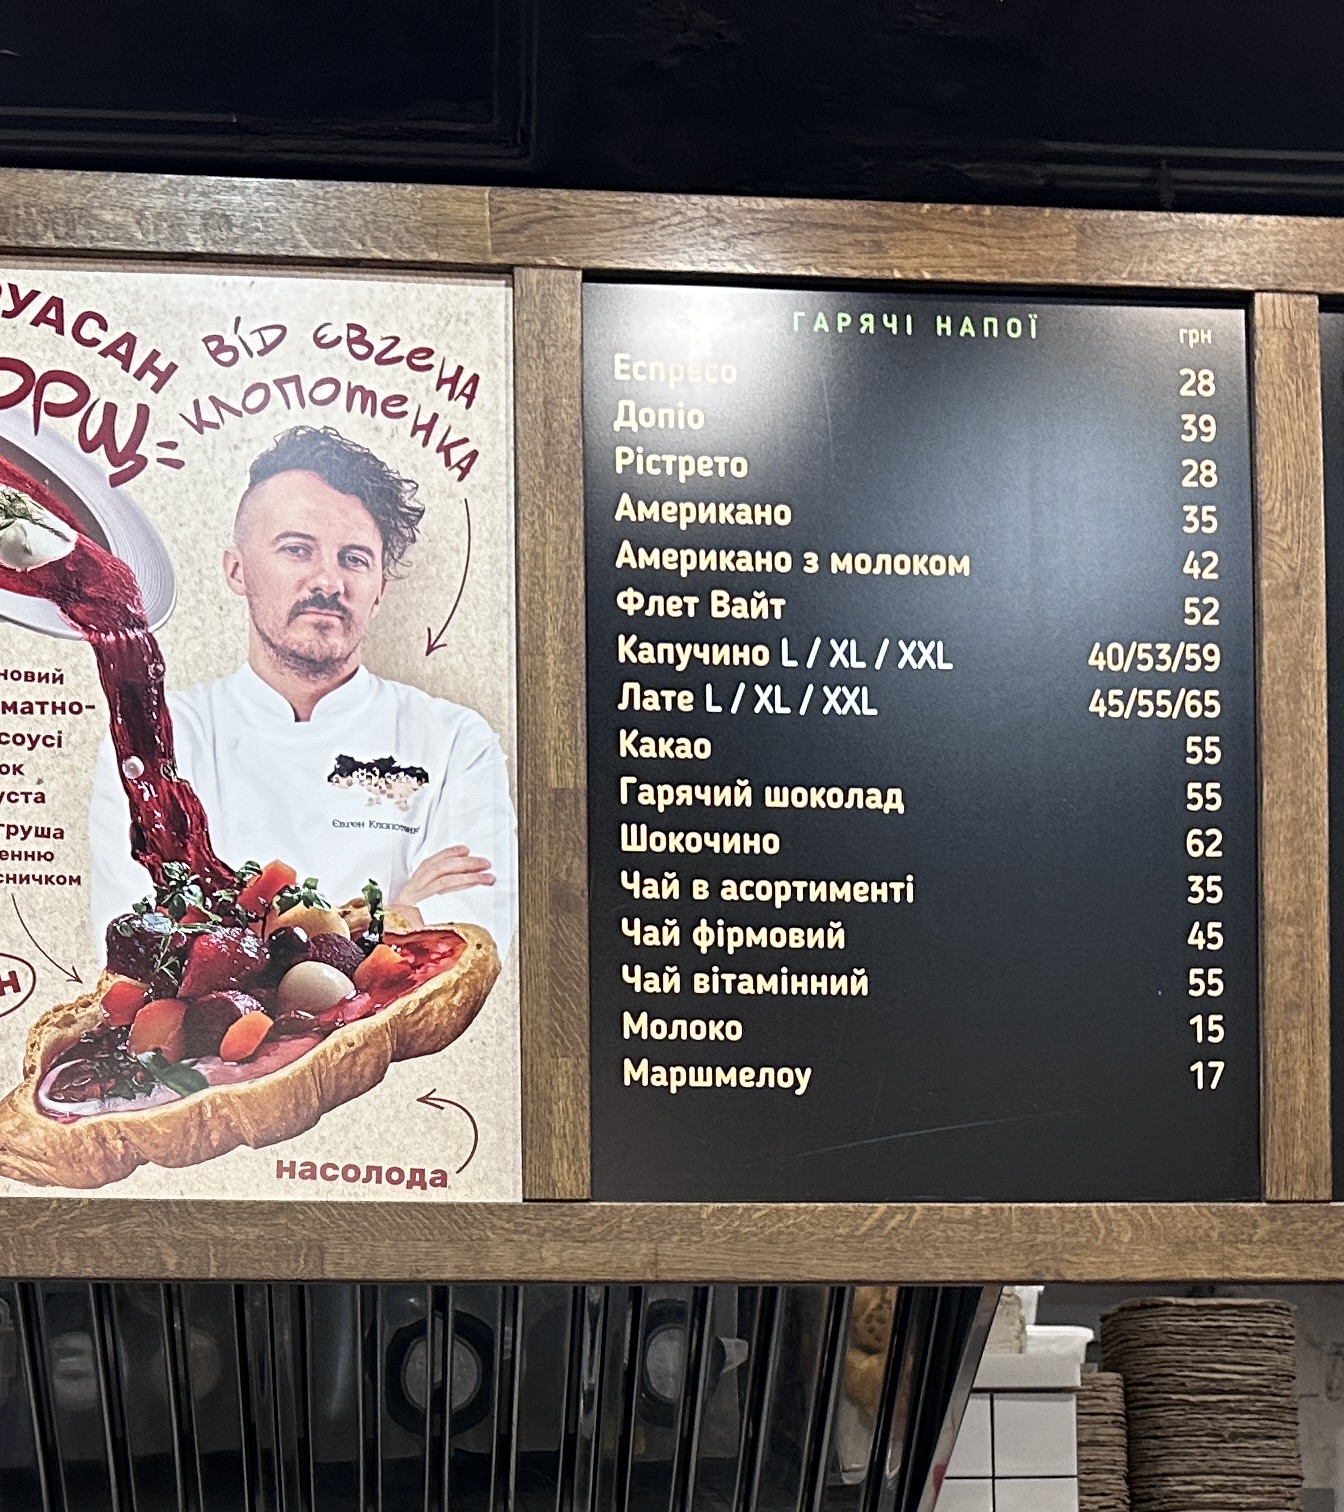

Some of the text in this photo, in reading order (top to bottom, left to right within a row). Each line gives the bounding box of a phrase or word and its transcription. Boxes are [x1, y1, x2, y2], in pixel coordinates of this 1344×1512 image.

[792, 311, 1211, 348] ГАРЯЧІ НАПОЇ грн
[614, 353, 1215, 397] Еспресо 28
[617, 587, 1219, 625] Флет Вайт 52
[618, 634, 1220, 673] Капучино L / XL / XXL 40/53/59
[621, 823, 1222, 857] Шокочино 62
[623, 1011, 1224, 1043] Молоко 15
[624, 1058, 1224, 1095] Маршмелоу 17
[276, 1160, 447, 1190] насолода
